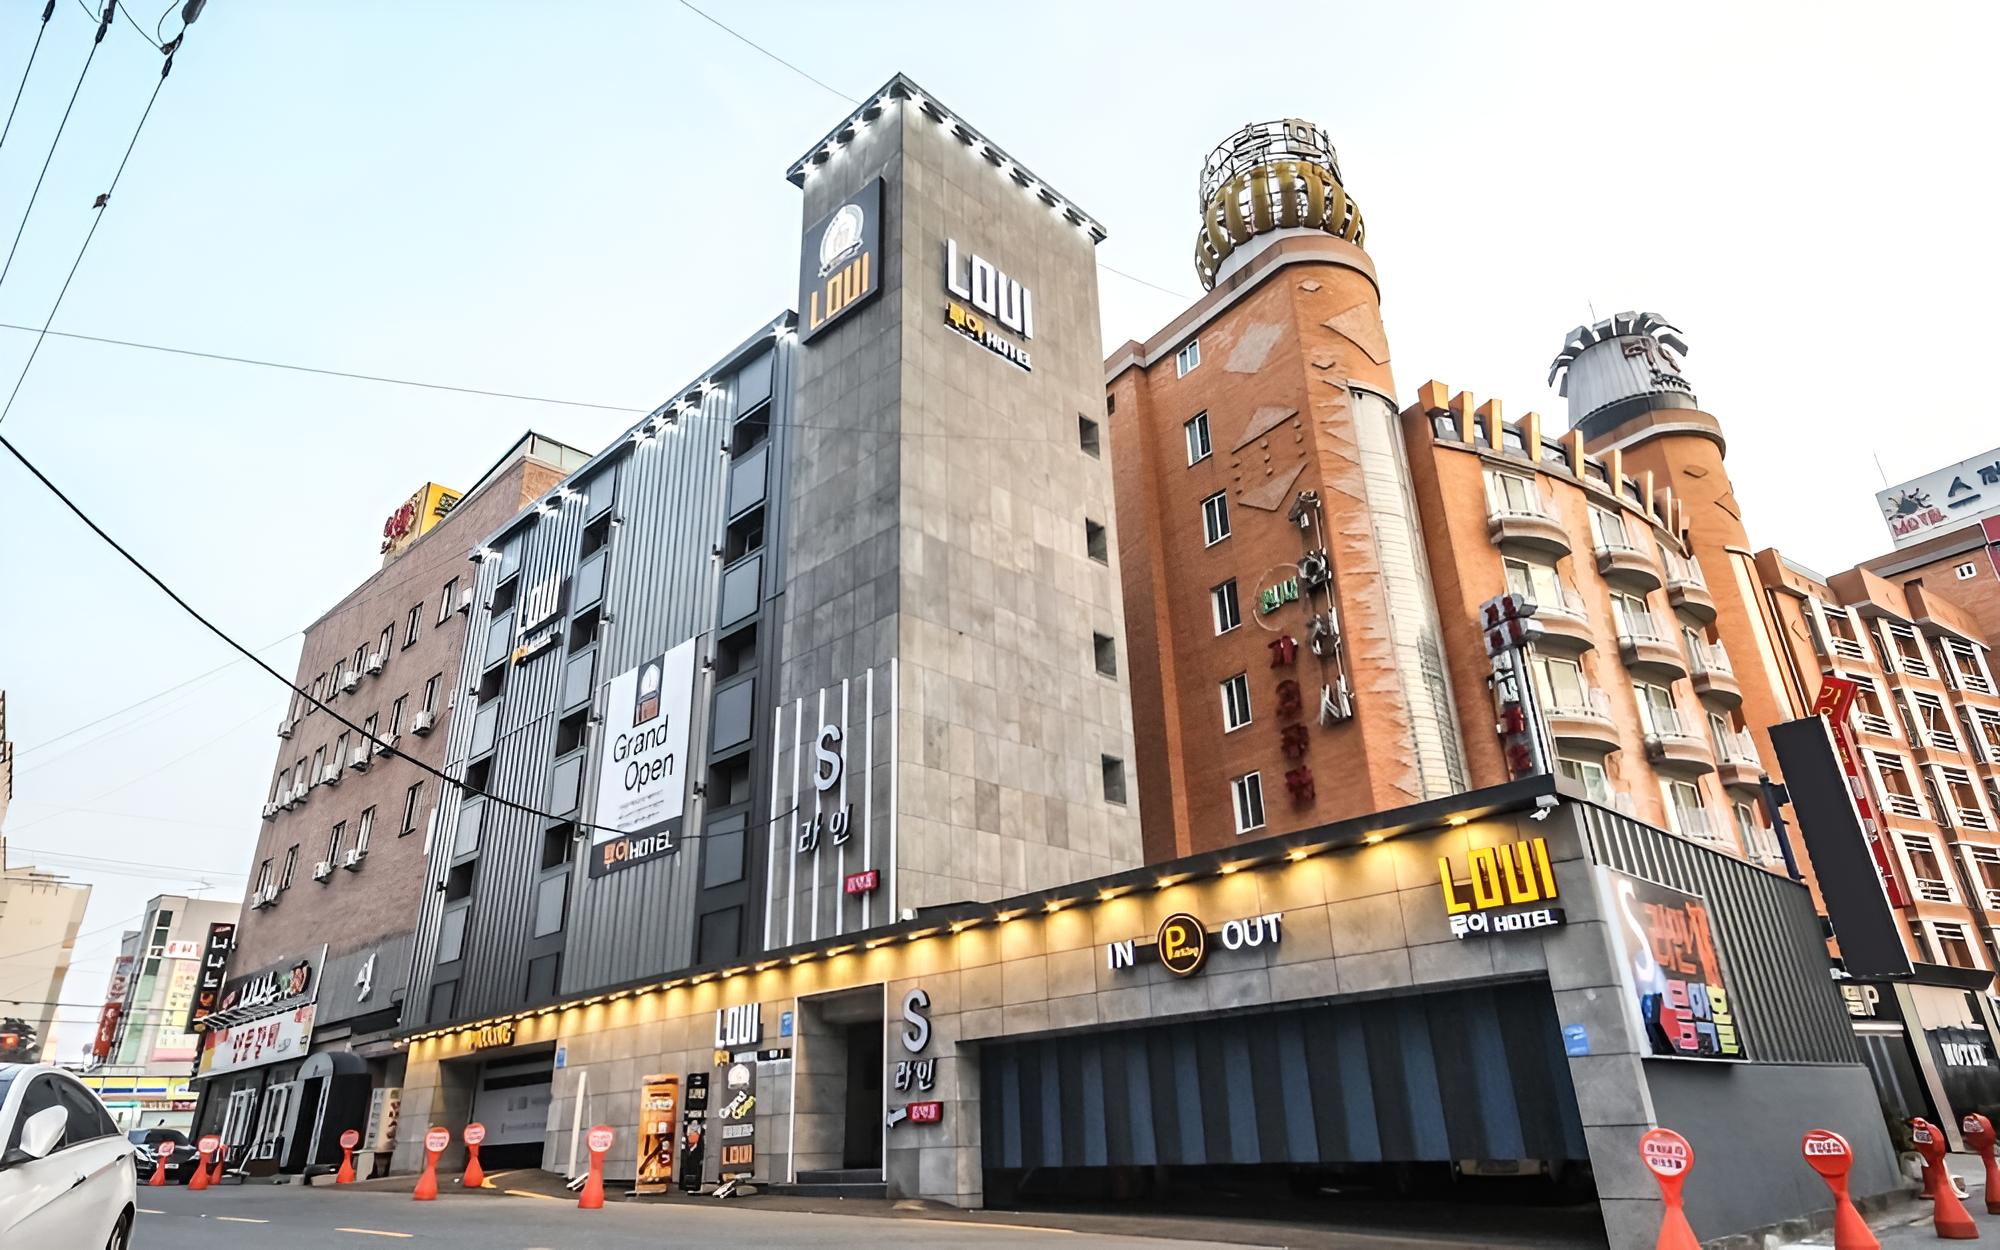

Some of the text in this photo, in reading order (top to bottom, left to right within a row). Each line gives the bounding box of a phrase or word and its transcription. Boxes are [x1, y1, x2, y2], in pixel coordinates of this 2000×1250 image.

[810, 251, 869, 331] LOUI
[946, 238, 1033, 340] LOUI
[985, 331, 1031, 369] HOTEL
[515, 569, 561, 638] LOUI
[613, 714, 669, 763] Grand
[814, 724, 843, 791] S
[624, 753, 674, 793] Open
[629, 830, 673, 860] HOTEL
[798, 804, 853, 853] 라인
[1439, 837, 1558, 915] LOUI
[1107, 940, 1137, 969] IN
[1221, 912, 1284, 950] OUT
[1449, 909, 1558, 939] 루이 HOTEL
[1618, 879, 1655, 982] S
[715, 1002, 760, 1050] LOUI
[902, 988, 930, 1053] S
[895, 1059, 936, 1092] 라인
[722, 1144, 752, 1165] LOUI
